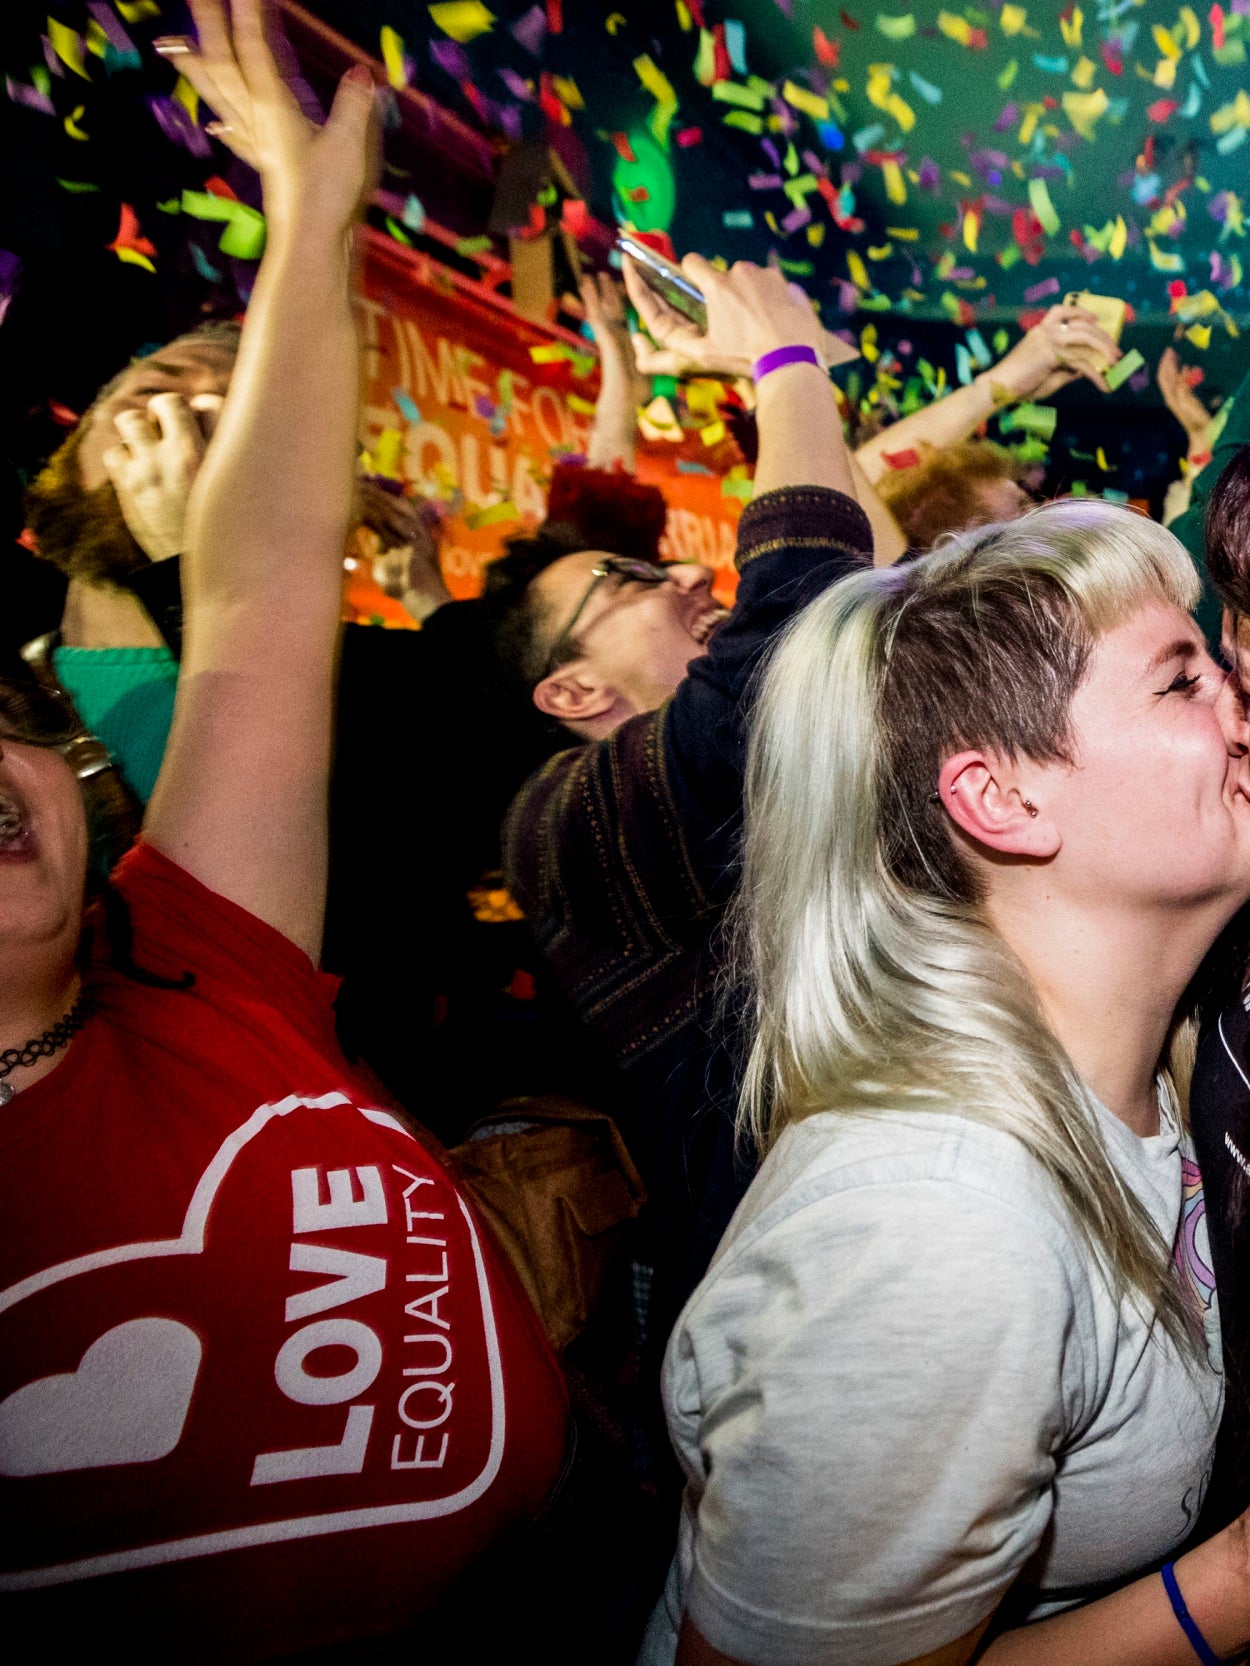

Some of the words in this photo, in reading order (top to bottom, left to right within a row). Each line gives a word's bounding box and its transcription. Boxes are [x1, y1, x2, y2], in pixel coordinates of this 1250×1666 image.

[351, 297, 491, 420] TIME
[359, 404, 549, 522] EQUA
[250, 1165, 388, 1487] LOVE
[391, 1163, 455, 1471] EQUALITY
